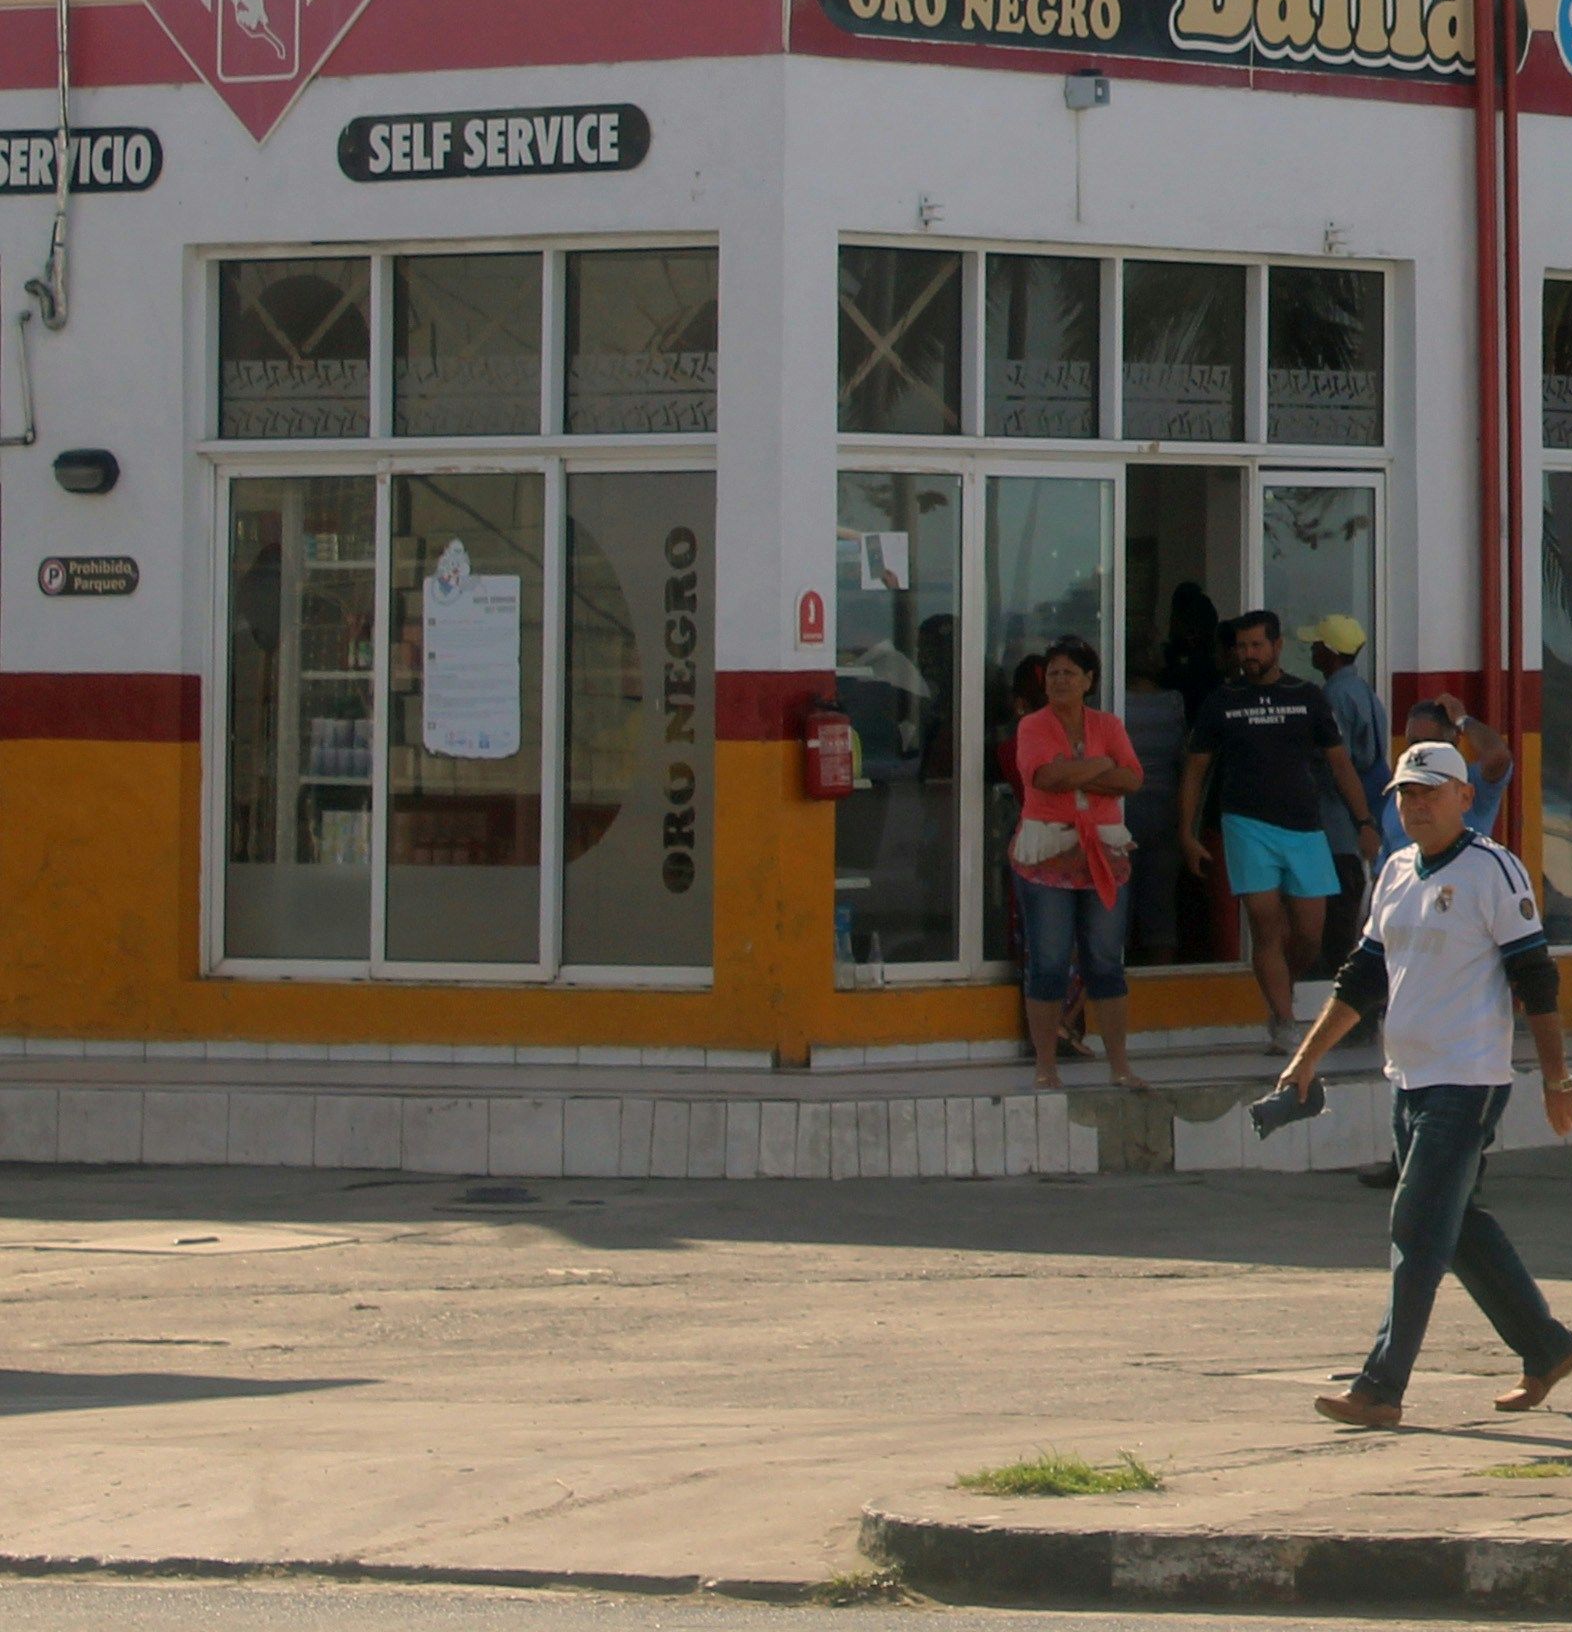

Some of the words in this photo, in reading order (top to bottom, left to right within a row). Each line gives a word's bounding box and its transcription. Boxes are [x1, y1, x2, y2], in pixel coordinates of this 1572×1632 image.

[368, 121, 452, 174] SELF
[463, 113, 620, 169] SERVICE
[69, 560, 133, 575] Prohibido
[664, 525, 699, 744] NEGRO
[662, 761, 697, 894] ORO
